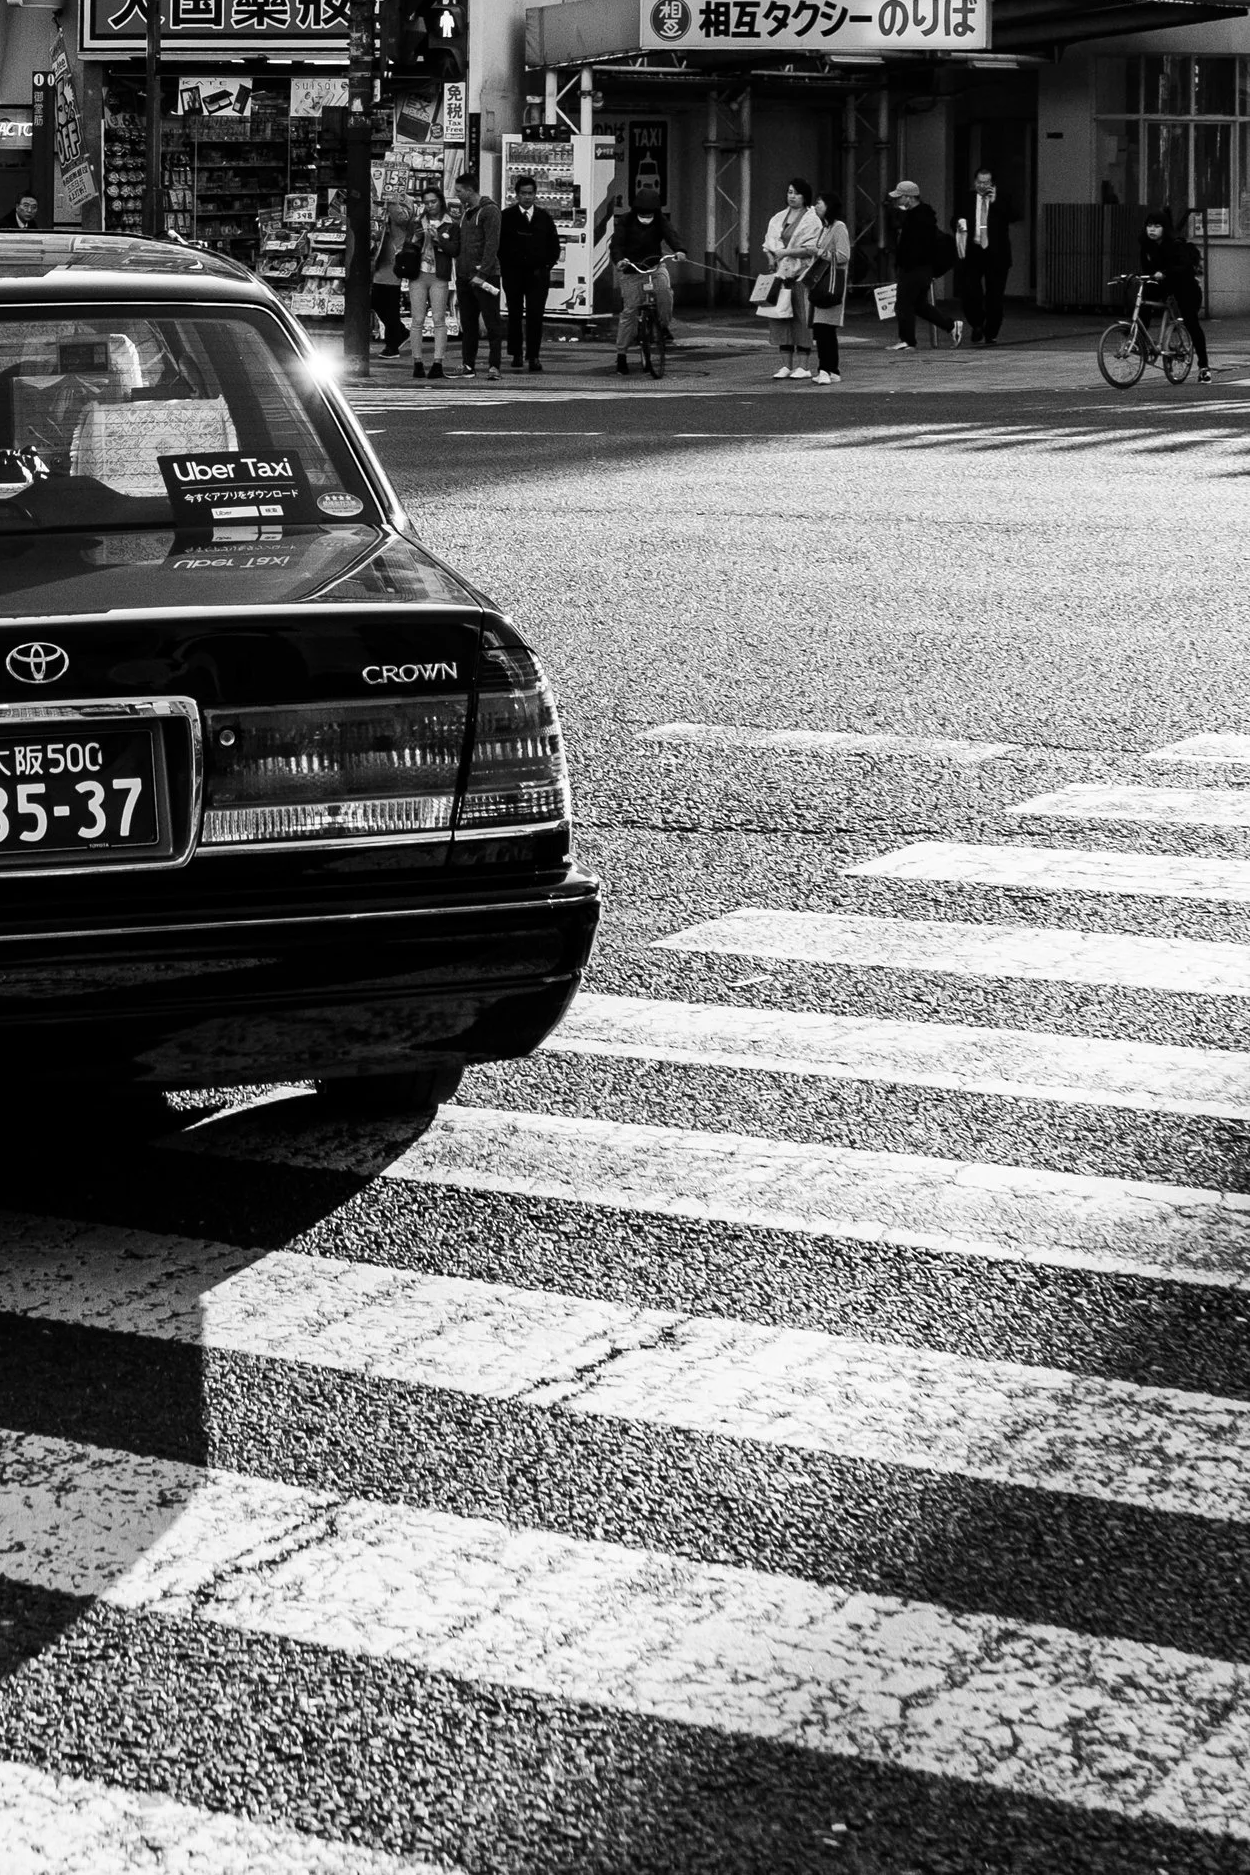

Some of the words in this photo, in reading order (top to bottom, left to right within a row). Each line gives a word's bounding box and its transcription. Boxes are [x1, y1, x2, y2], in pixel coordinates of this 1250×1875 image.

[447, 84, 463, 120] 免税
[633, 126, 663, 147] TAXI
[383, 185, 407, 194] OFF
[173, 461, 236, 481] Uber
[240, 458, 293, 477] Taxi
[184, 489, 299, 503] 今すぐアプリをダウンロード
[362, 662, 458, 686] CROWN
